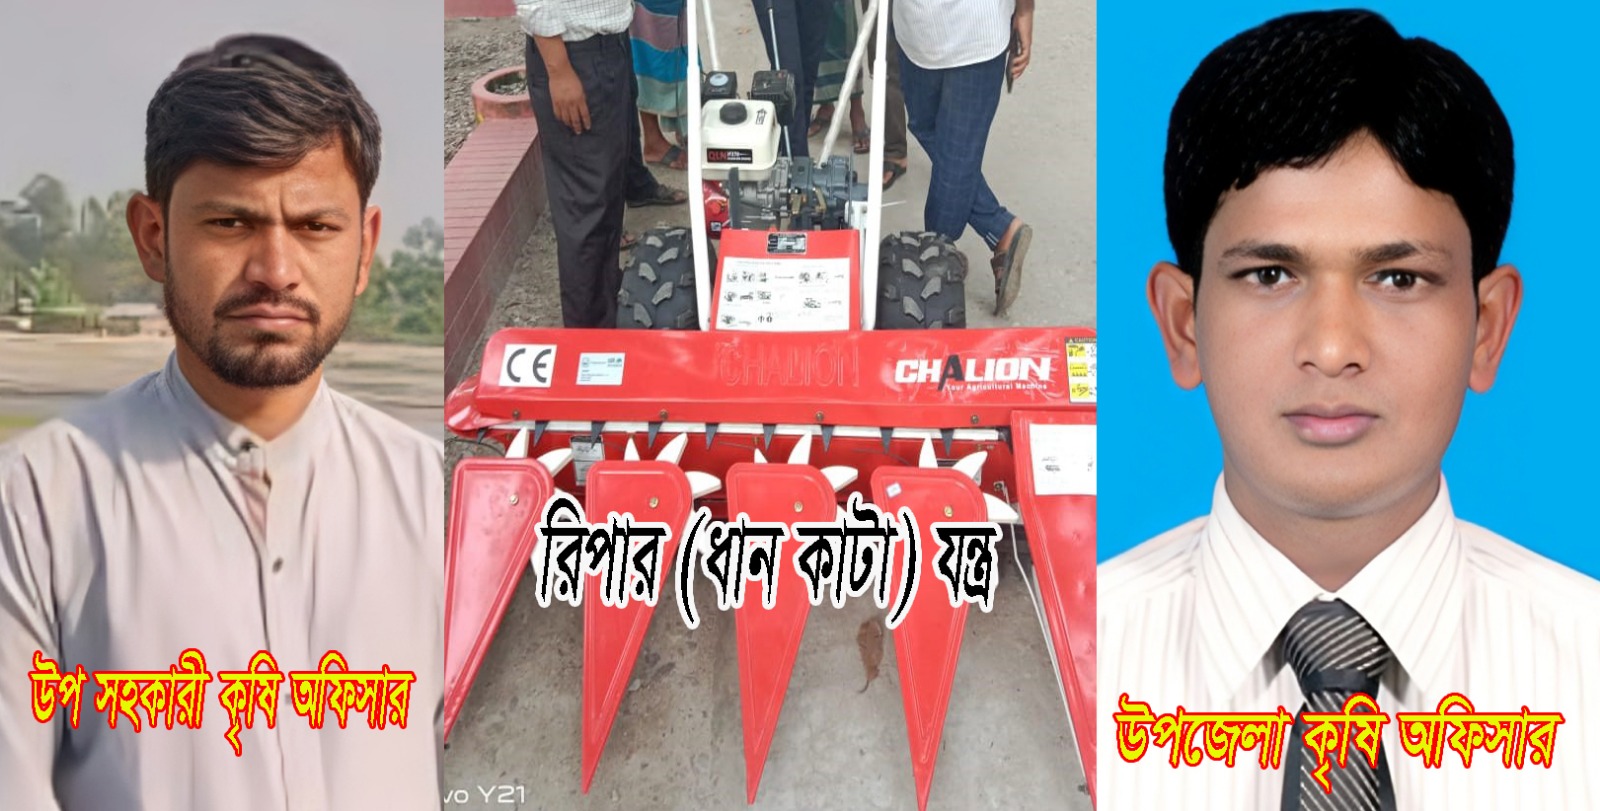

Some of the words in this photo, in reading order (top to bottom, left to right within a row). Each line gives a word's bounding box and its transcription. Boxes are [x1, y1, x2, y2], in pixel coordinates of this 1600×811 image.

[506, 348, 552, 382] CE
[895, 354, 1051, 391] CHALION
[966, 383, 1013, 392] Agricultural
